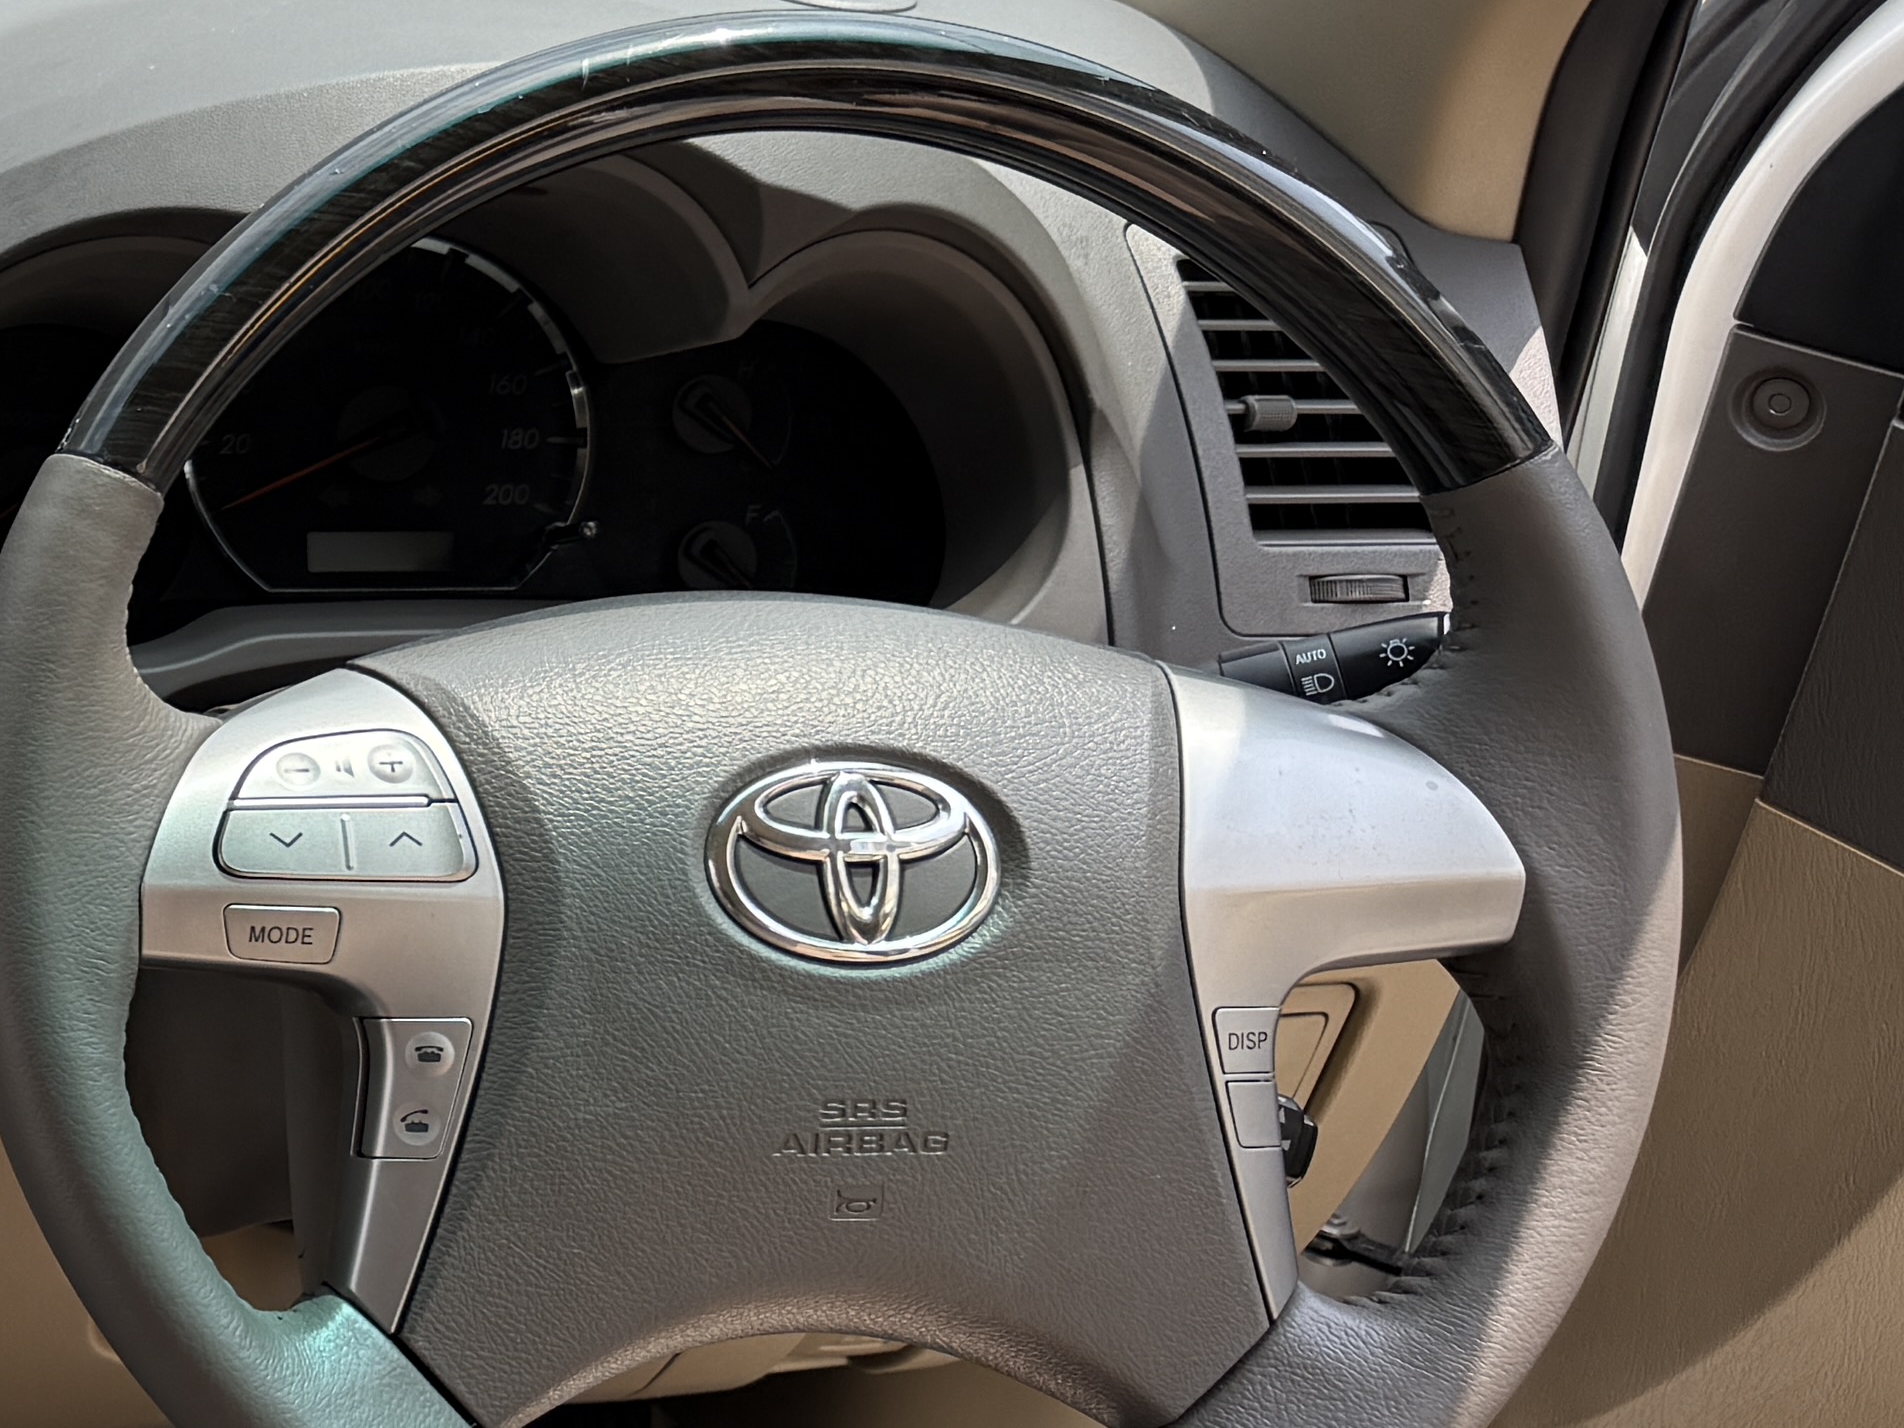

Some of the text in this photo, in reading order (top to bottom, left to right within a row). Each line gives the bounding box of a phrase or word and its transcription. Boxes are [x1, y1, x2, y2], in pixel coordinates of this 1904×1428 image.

[218, 433, 252, 456] 20
[500, 428, 540, 450] 180
[482, 484, 530, 507] 200
[1295, 648, 1327, 665] AUTO
[248, 925, 314, 945] MODE
[1228, 1031, 1268, 1050] DISP
[819, 1099, 908, 1123] SRS
[772, 1131, 950, 1157] AIRBAG
